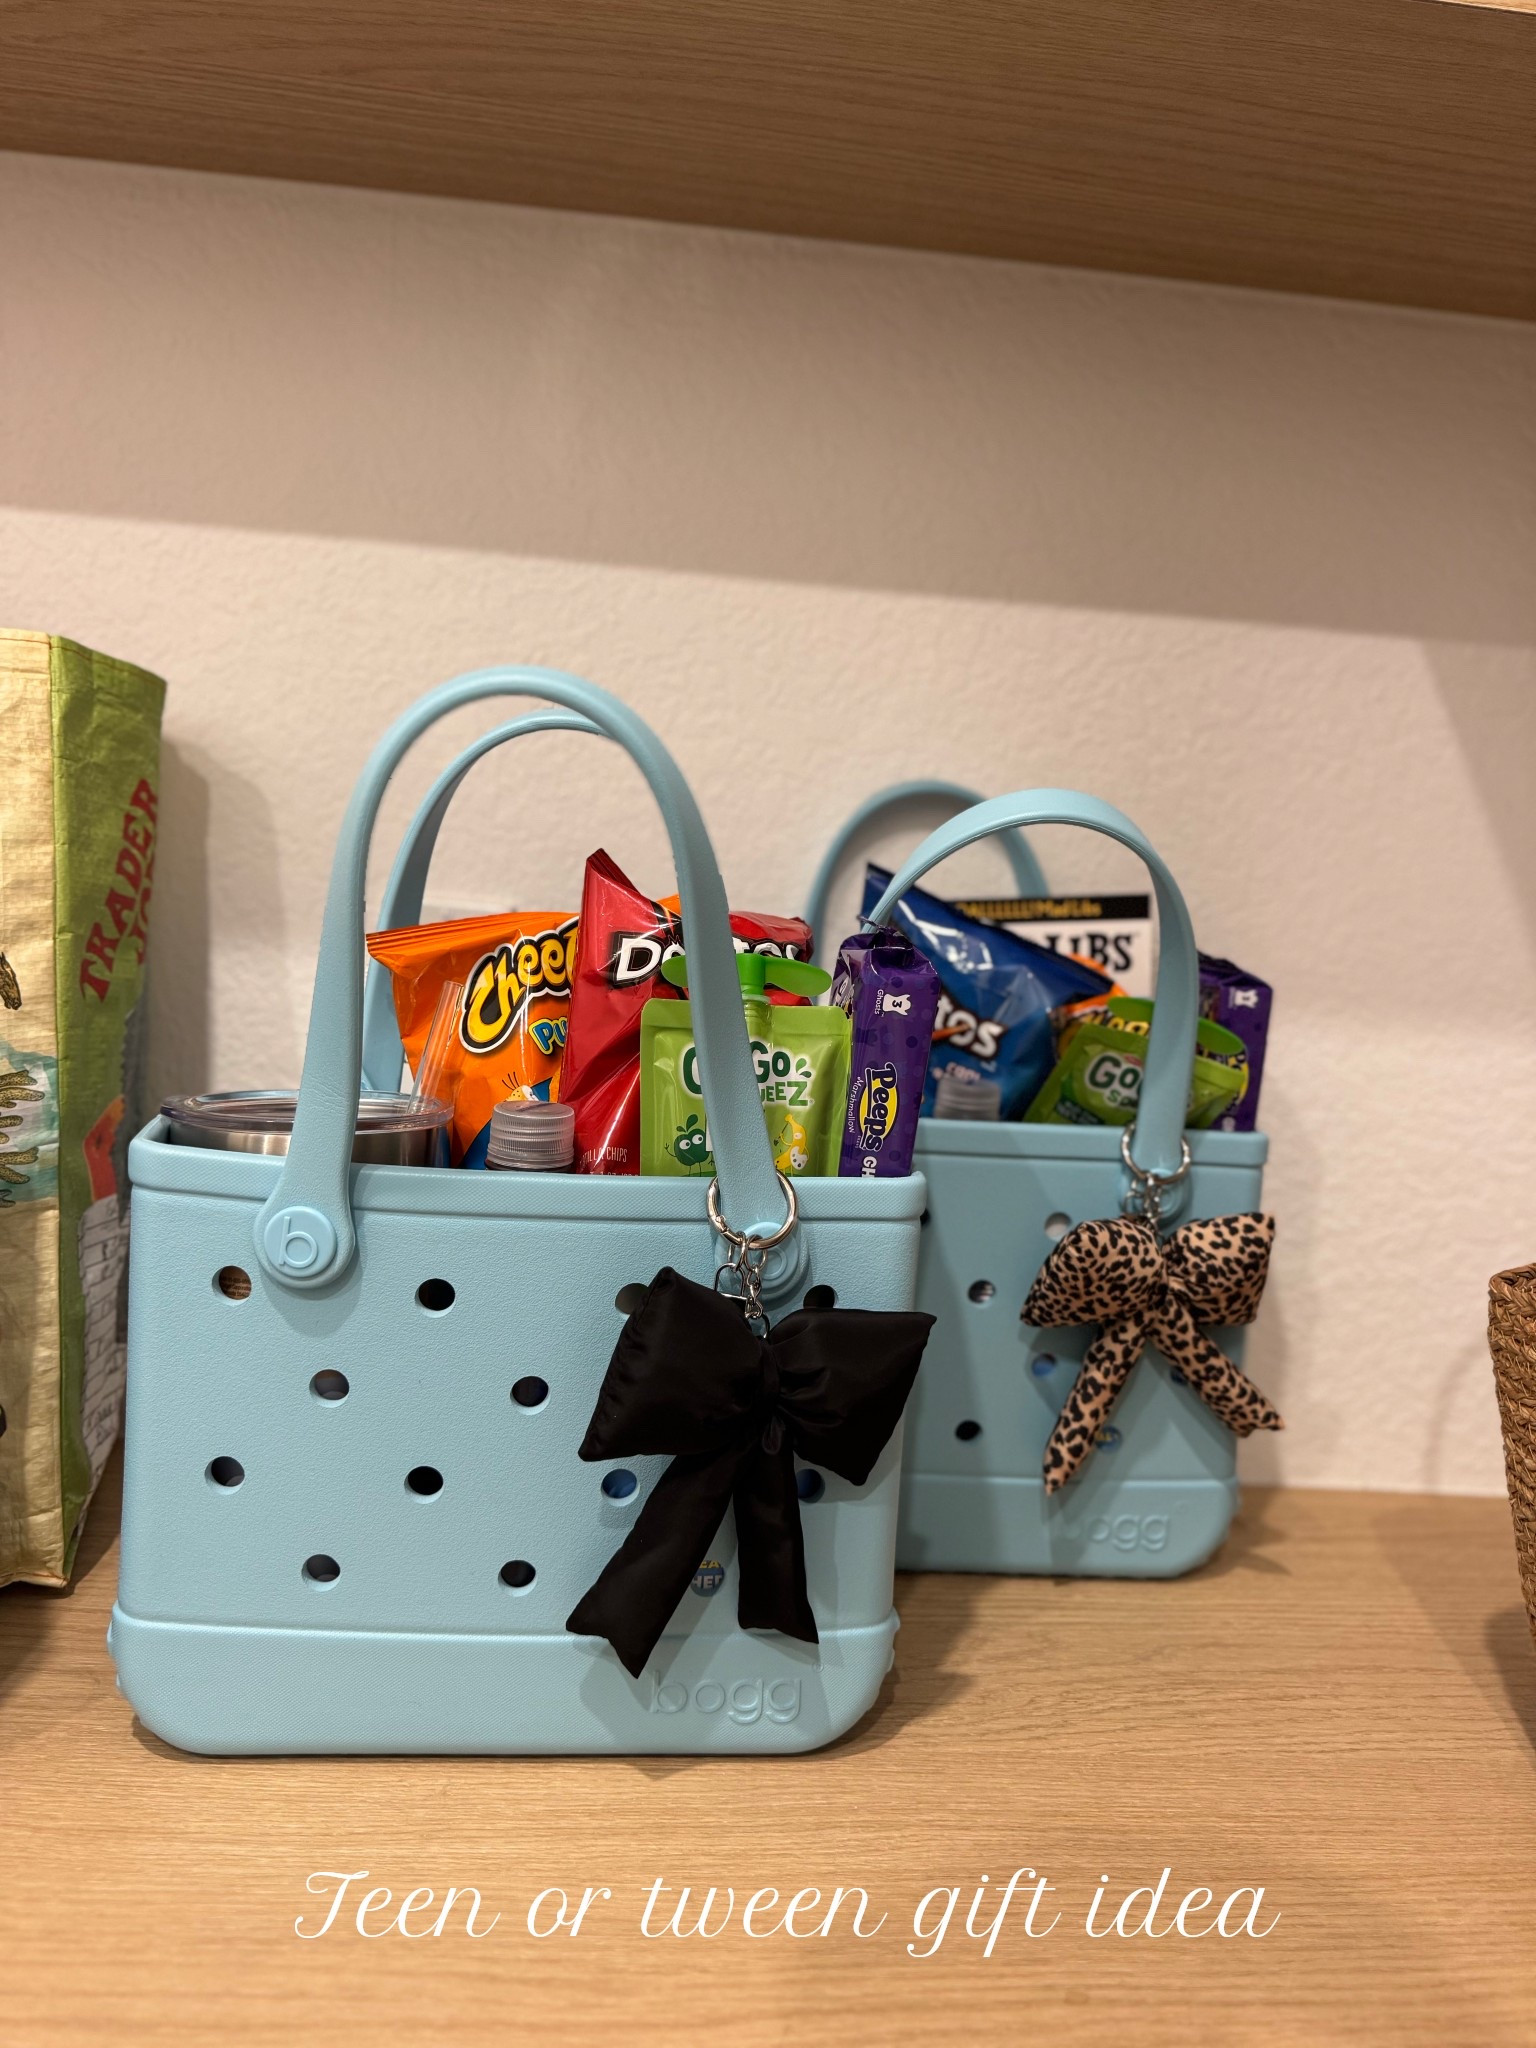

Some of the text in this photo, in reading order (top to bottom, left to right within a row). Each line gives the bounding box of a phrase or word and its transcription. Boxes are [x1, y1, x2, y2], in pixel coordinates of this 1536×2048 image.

[80, 779, 158, 1002] TRADER
[874, 989, 884, 1015] Ghosts
[848, 1076, 865, 1134] Marshmallow
[865, 1062, 898, 1152] Peeps
[606, 1146, 627, 1163] CHIPS
[279, 1215, 318, 1268] b
[648, 1670, 802, 1724] bogg
